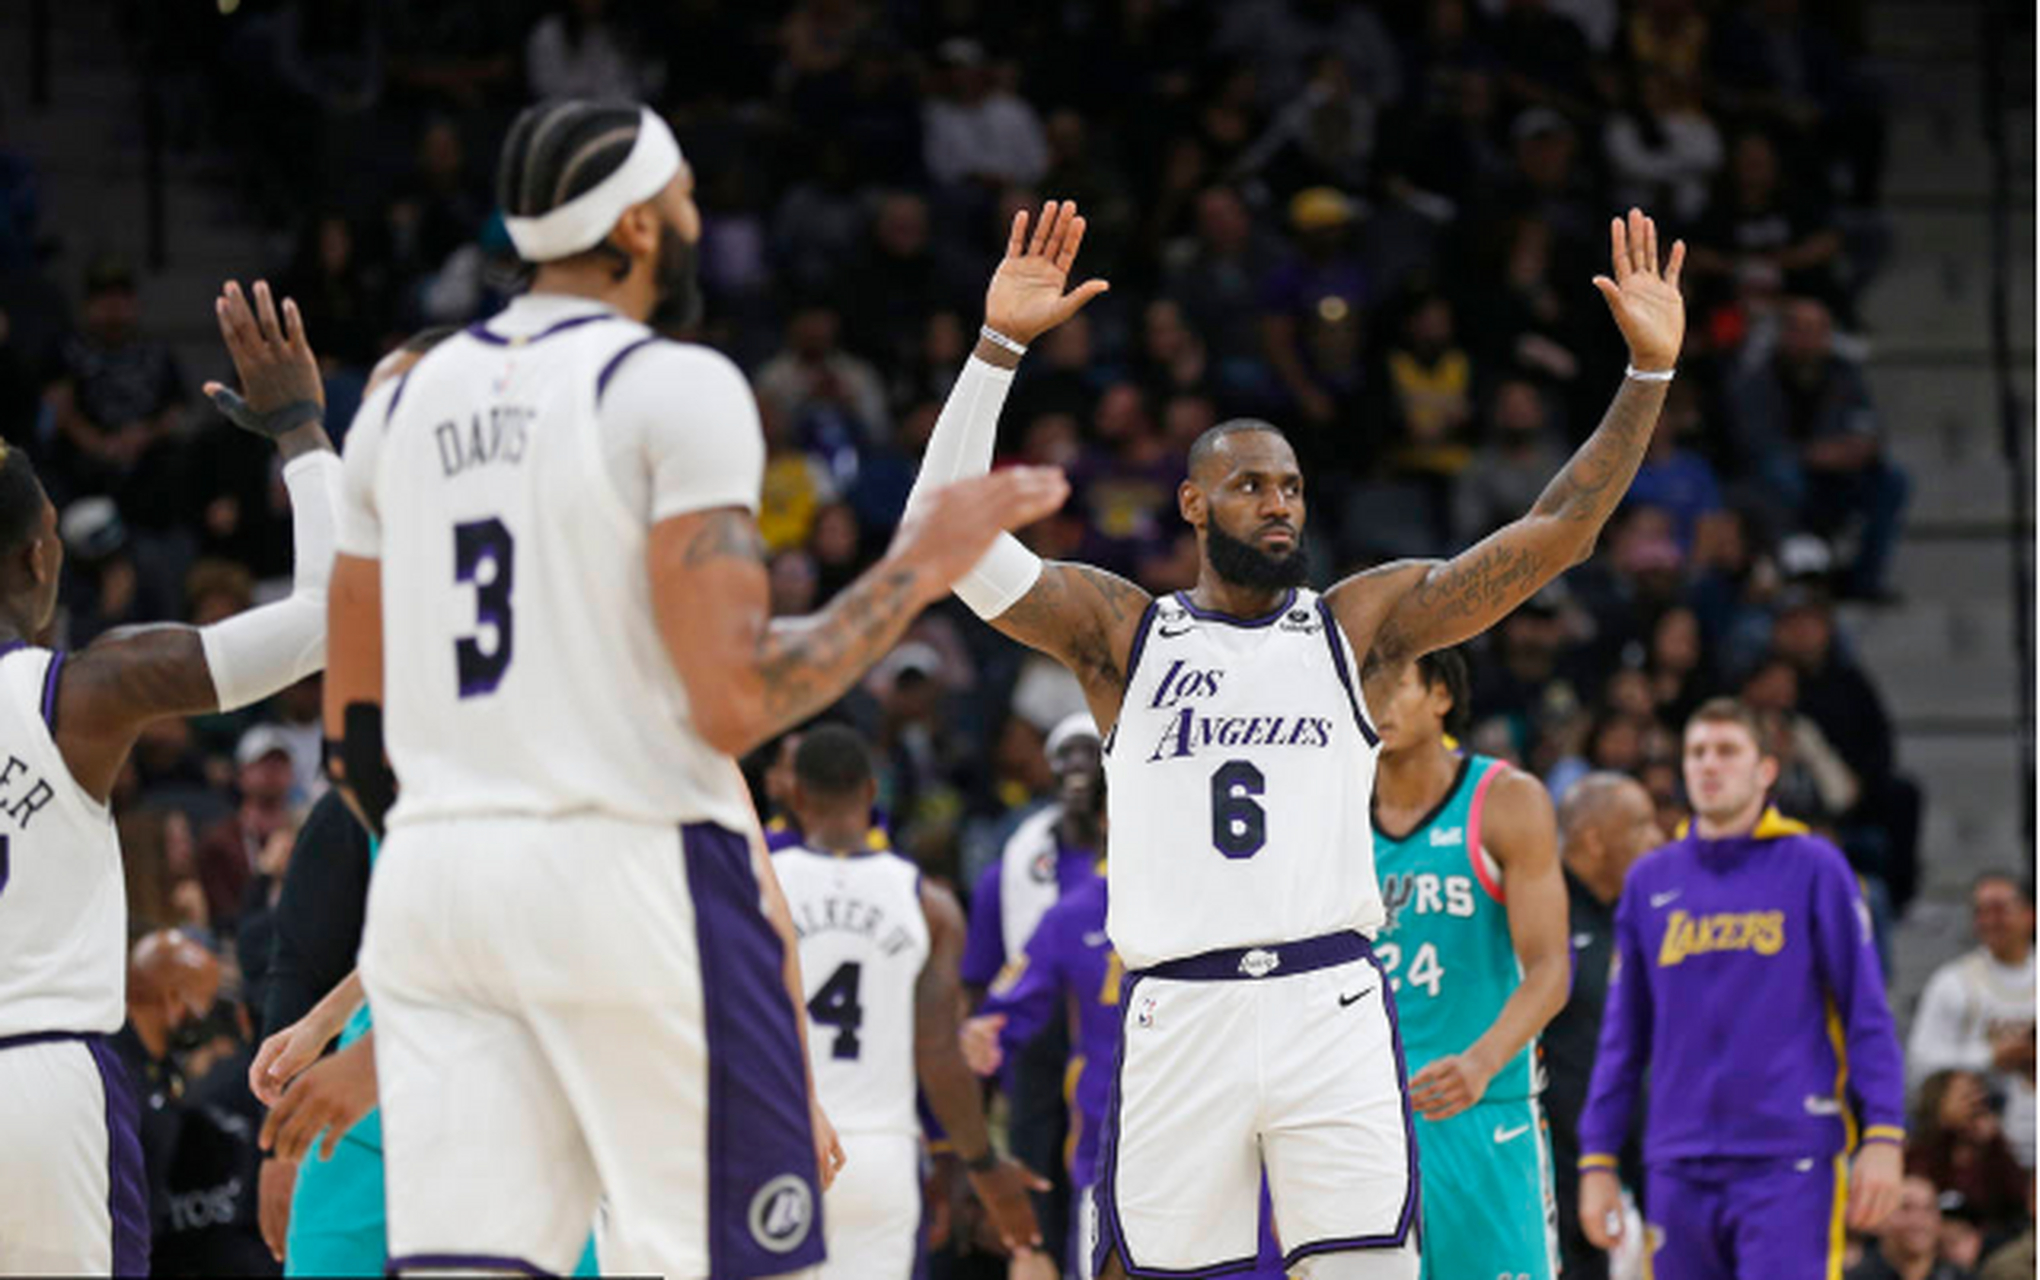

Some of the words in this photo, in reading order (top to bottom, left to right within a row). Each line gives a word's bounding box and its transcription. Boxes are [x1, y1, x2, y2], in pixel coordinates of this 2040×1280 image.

[454, 516, 515, 699] 3
[1210, 759, 1267, 860] 6
[807, 961, 862, 1060] 4
